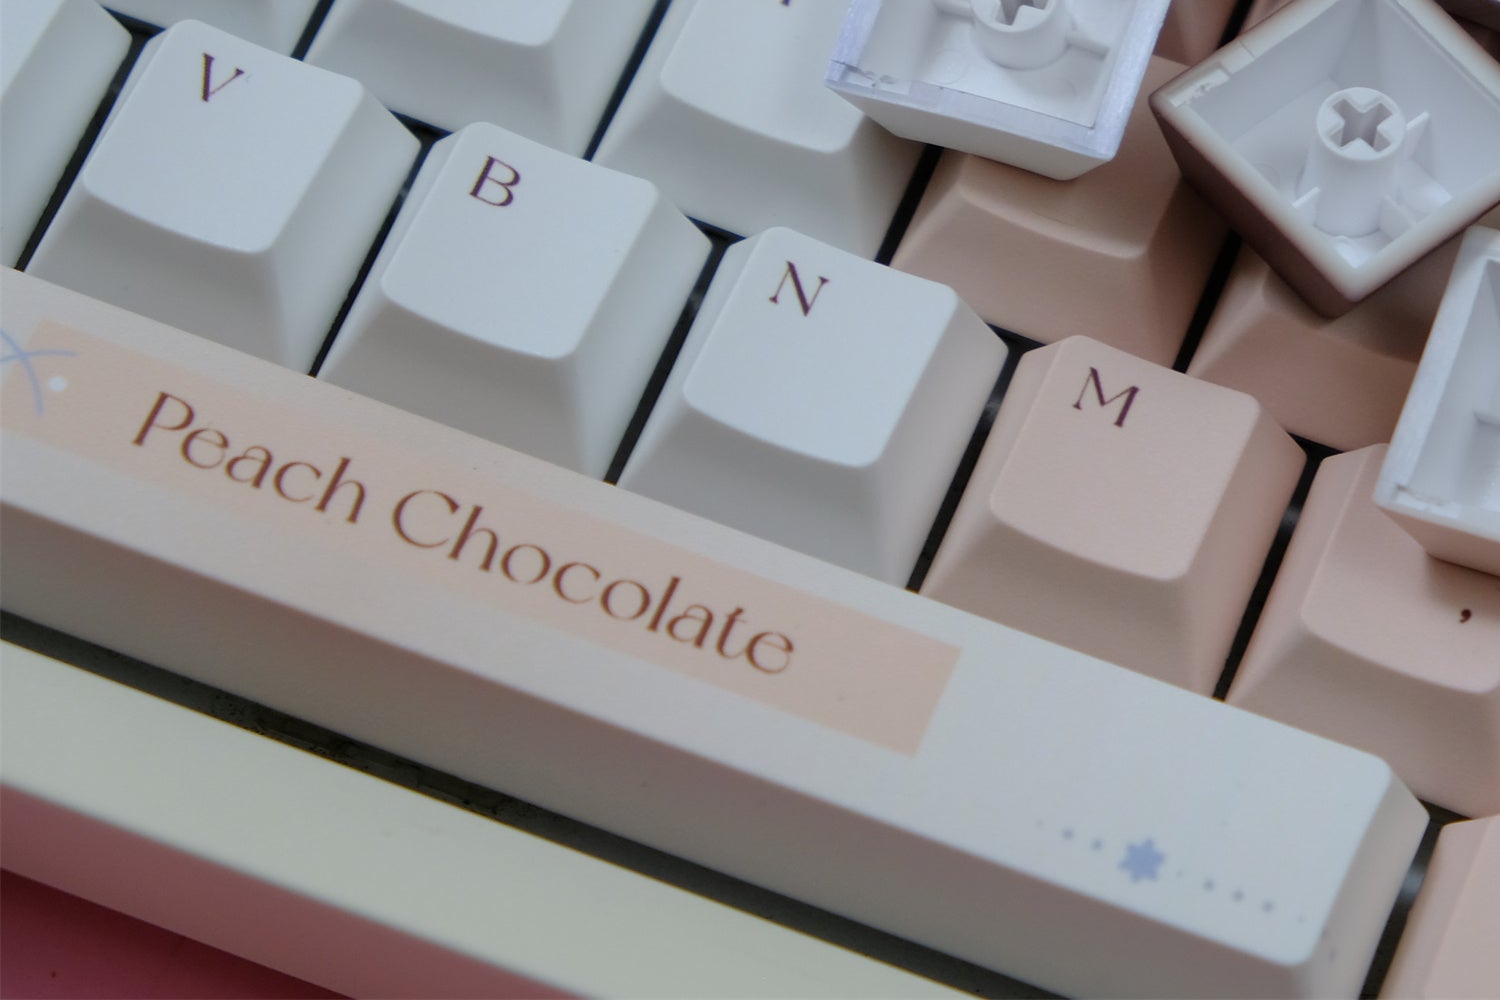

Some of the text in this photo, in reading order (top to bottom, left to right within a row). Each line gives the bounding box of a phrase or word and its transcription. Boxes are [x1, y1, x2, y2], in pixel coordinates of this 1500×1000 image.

[202, 53, 244, 102] V
[470, 156, 520, 206] B
[769, 261, 828, 316] N
[1072, 366, 1141, 428] M
[133, 392, 796, 676] Peach Chocolate
